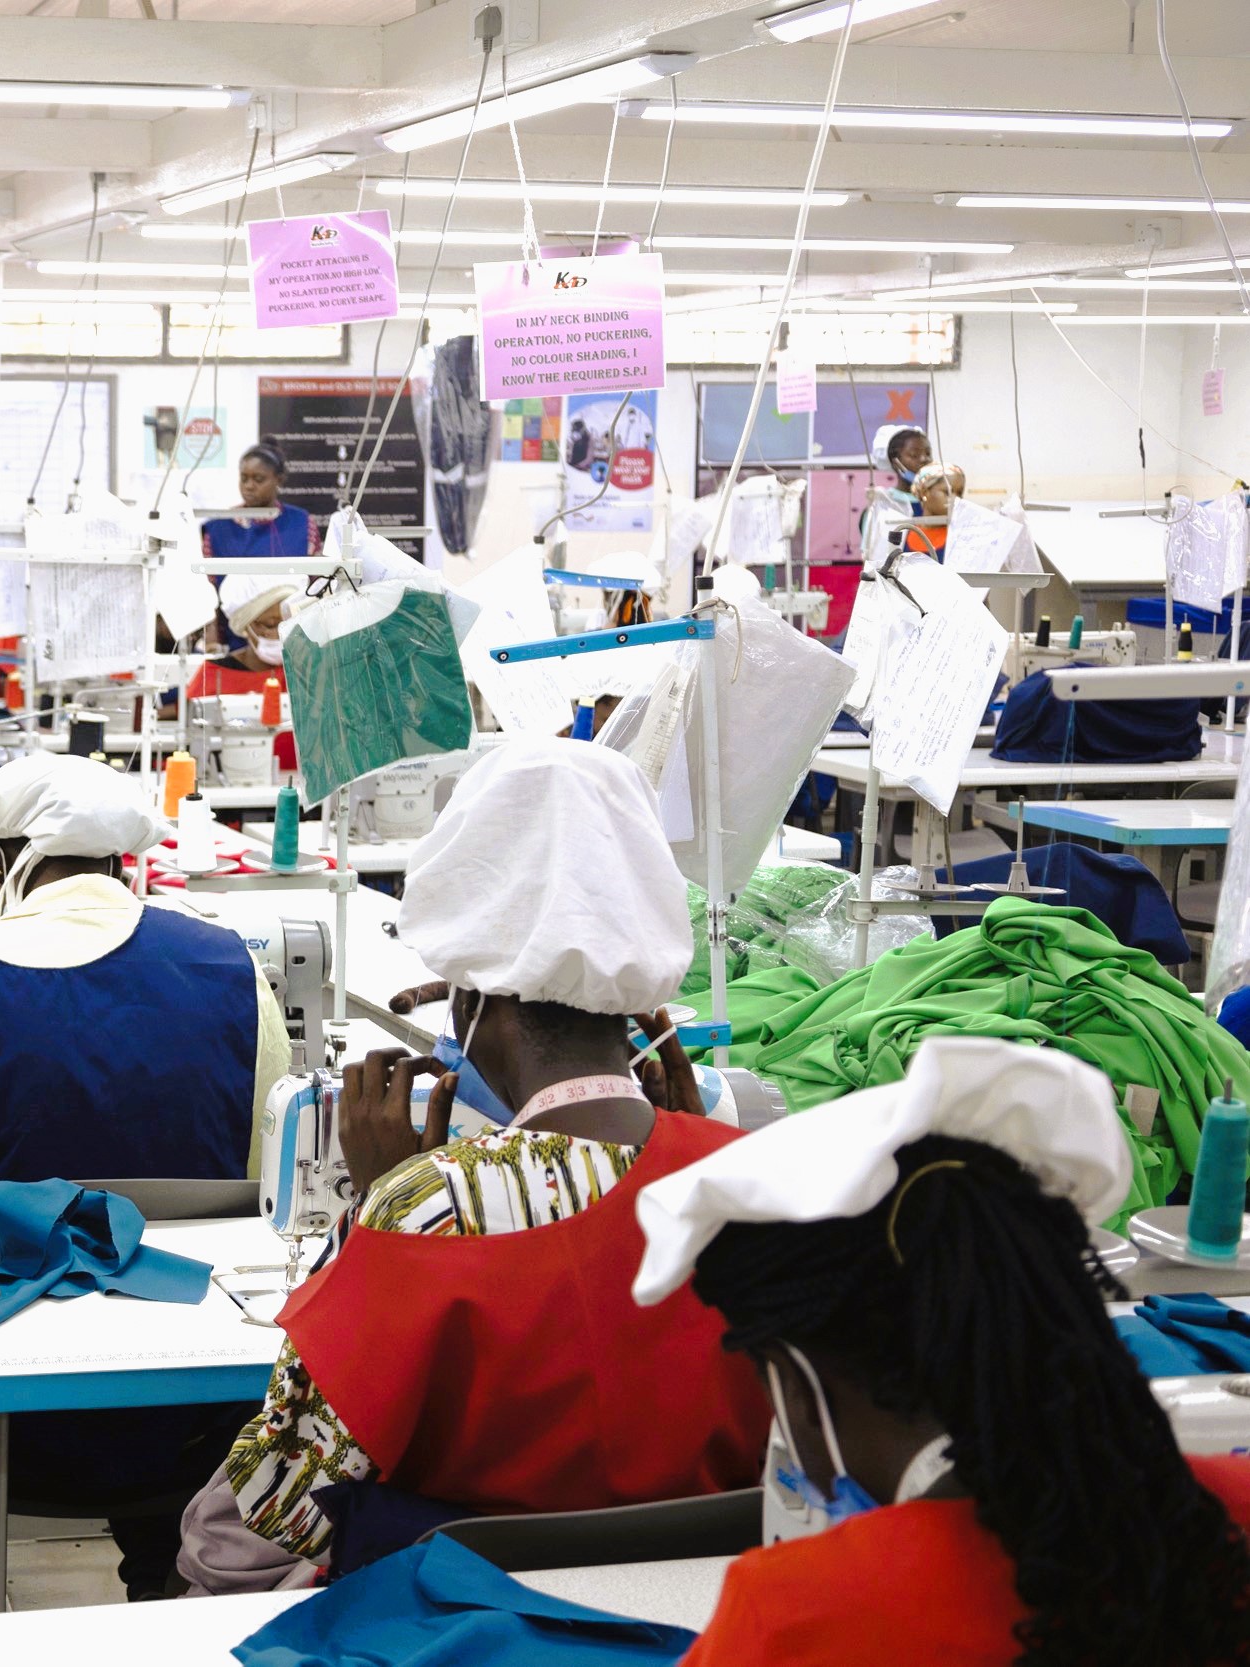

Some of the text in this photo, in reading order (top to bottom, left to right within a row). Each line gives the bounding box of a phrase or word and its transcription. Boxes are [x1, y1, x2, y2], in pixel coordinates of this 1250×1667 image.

[280, 260, 313, 270] POCKET
[316, 256, 360, 267] ATTACHING
[268, 276, 282, 285] MY
[279, 291, 290, 299] NO
[292, 286, 328, 297] SLANTED
[365, 282, 375, 290] NO
[319, 300, 330, 308] NO
[331, 297, 358, 306] CURVE
[516, 310, 629, 328] IN MY NECK BINDING
[494, 328, 652, 348] OPERATION, NO PUCKERING,
[511, 348, 637, 367] NO COLOUR SHADING, I
[502, 365, 647, 386] KNOW THE REQUIRED S.P.I
[538, 1093, 555, 1108] 32
[567, 1086, 586, 1098] 33
[598, 1082, 615, 1094] 34
[623, 1082, 637, 1095] 35
